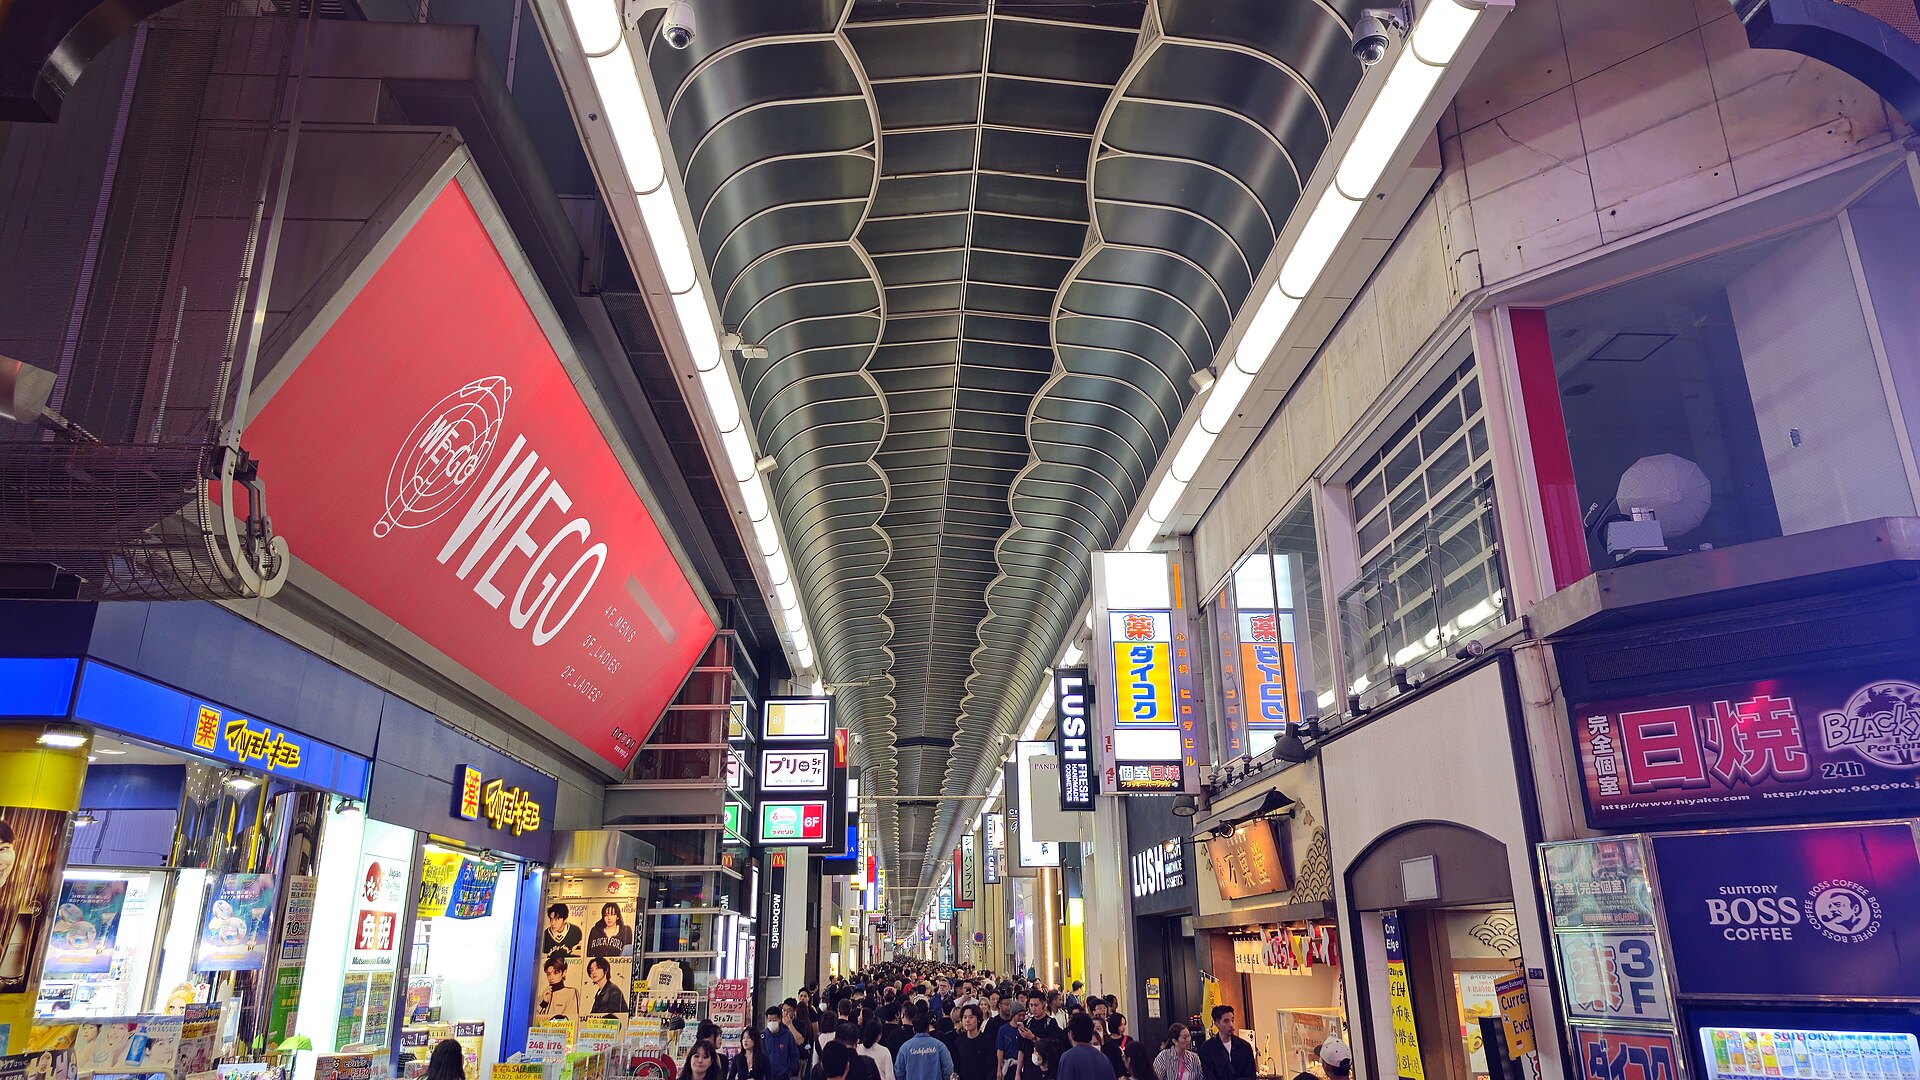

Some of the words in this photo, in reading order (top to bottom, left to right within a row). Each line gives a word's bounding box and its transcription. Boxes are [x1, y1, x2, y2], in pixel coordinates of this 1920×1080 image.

[419, 414, 479, 486] WEGO
[436, 433, 608, 646] WEGO
[1124, 614, 1155, 641] 薬
[1130, 645, 1158, 719] ダイコク
[197, 710, 218, 748] 薬
[1061, 677, 1087, 759] LUSH
[226, 721, 299, 768] マツモトキヨシ
[1587, 715, 1621, 796] 完全個室
[1619, 694, 1811, 789] 日焼
[769, 757, 797, 775] プリ
[812, 758, 821, 766] 5F
[812, 767, 821, 775] 7F
[1106, 767, 1115, 784] 4F
[1119, 765, 1181, 781] 個室日焼
[1822, 761, 1866, 779] 24h
[464, 771, 479, 816] 薬
[1065, 764, 1073, 802] COSMETICS
[1071, 764, 1079, 802] HANDMADE
[1078, 764, 1089, 802] FRESH
[484, 779, 540, 836] マツモトキヨシ
[1601, 793, 1751, 811] http://www.hiyake.com
[804, 816, 819, 828] 6F
[964, 837, 974, 898] ジャパンライフ
[1133, 844, 1166, 897] LUSH
[1719, 884, 1778, 895] SUNTORY
[1808, 880, 1830, 897] BOSS
[1832, 879, 1870, 897] COFFEE
[771, 894, 781, 949] McDonald's
[1705, 896, 1801, 926] BOSS
[1804, 899, 1822, 930] COFFEE
[1867, 896, 1883, 919] BOSS
[360, 914, 393, 949] 免税
[1724, 927, 1793, 941] COFFEE
[1822, 929, 1848, 943] BOSS
[1852, 921, 1881, 944] COFFEE
[717, 983, 744, 991] カラコン
[1619, 939, 1657, 1014] 3F
[712, 1002, 743, 1010] プリショップ
[529, 1041, 543, 1049] 248
